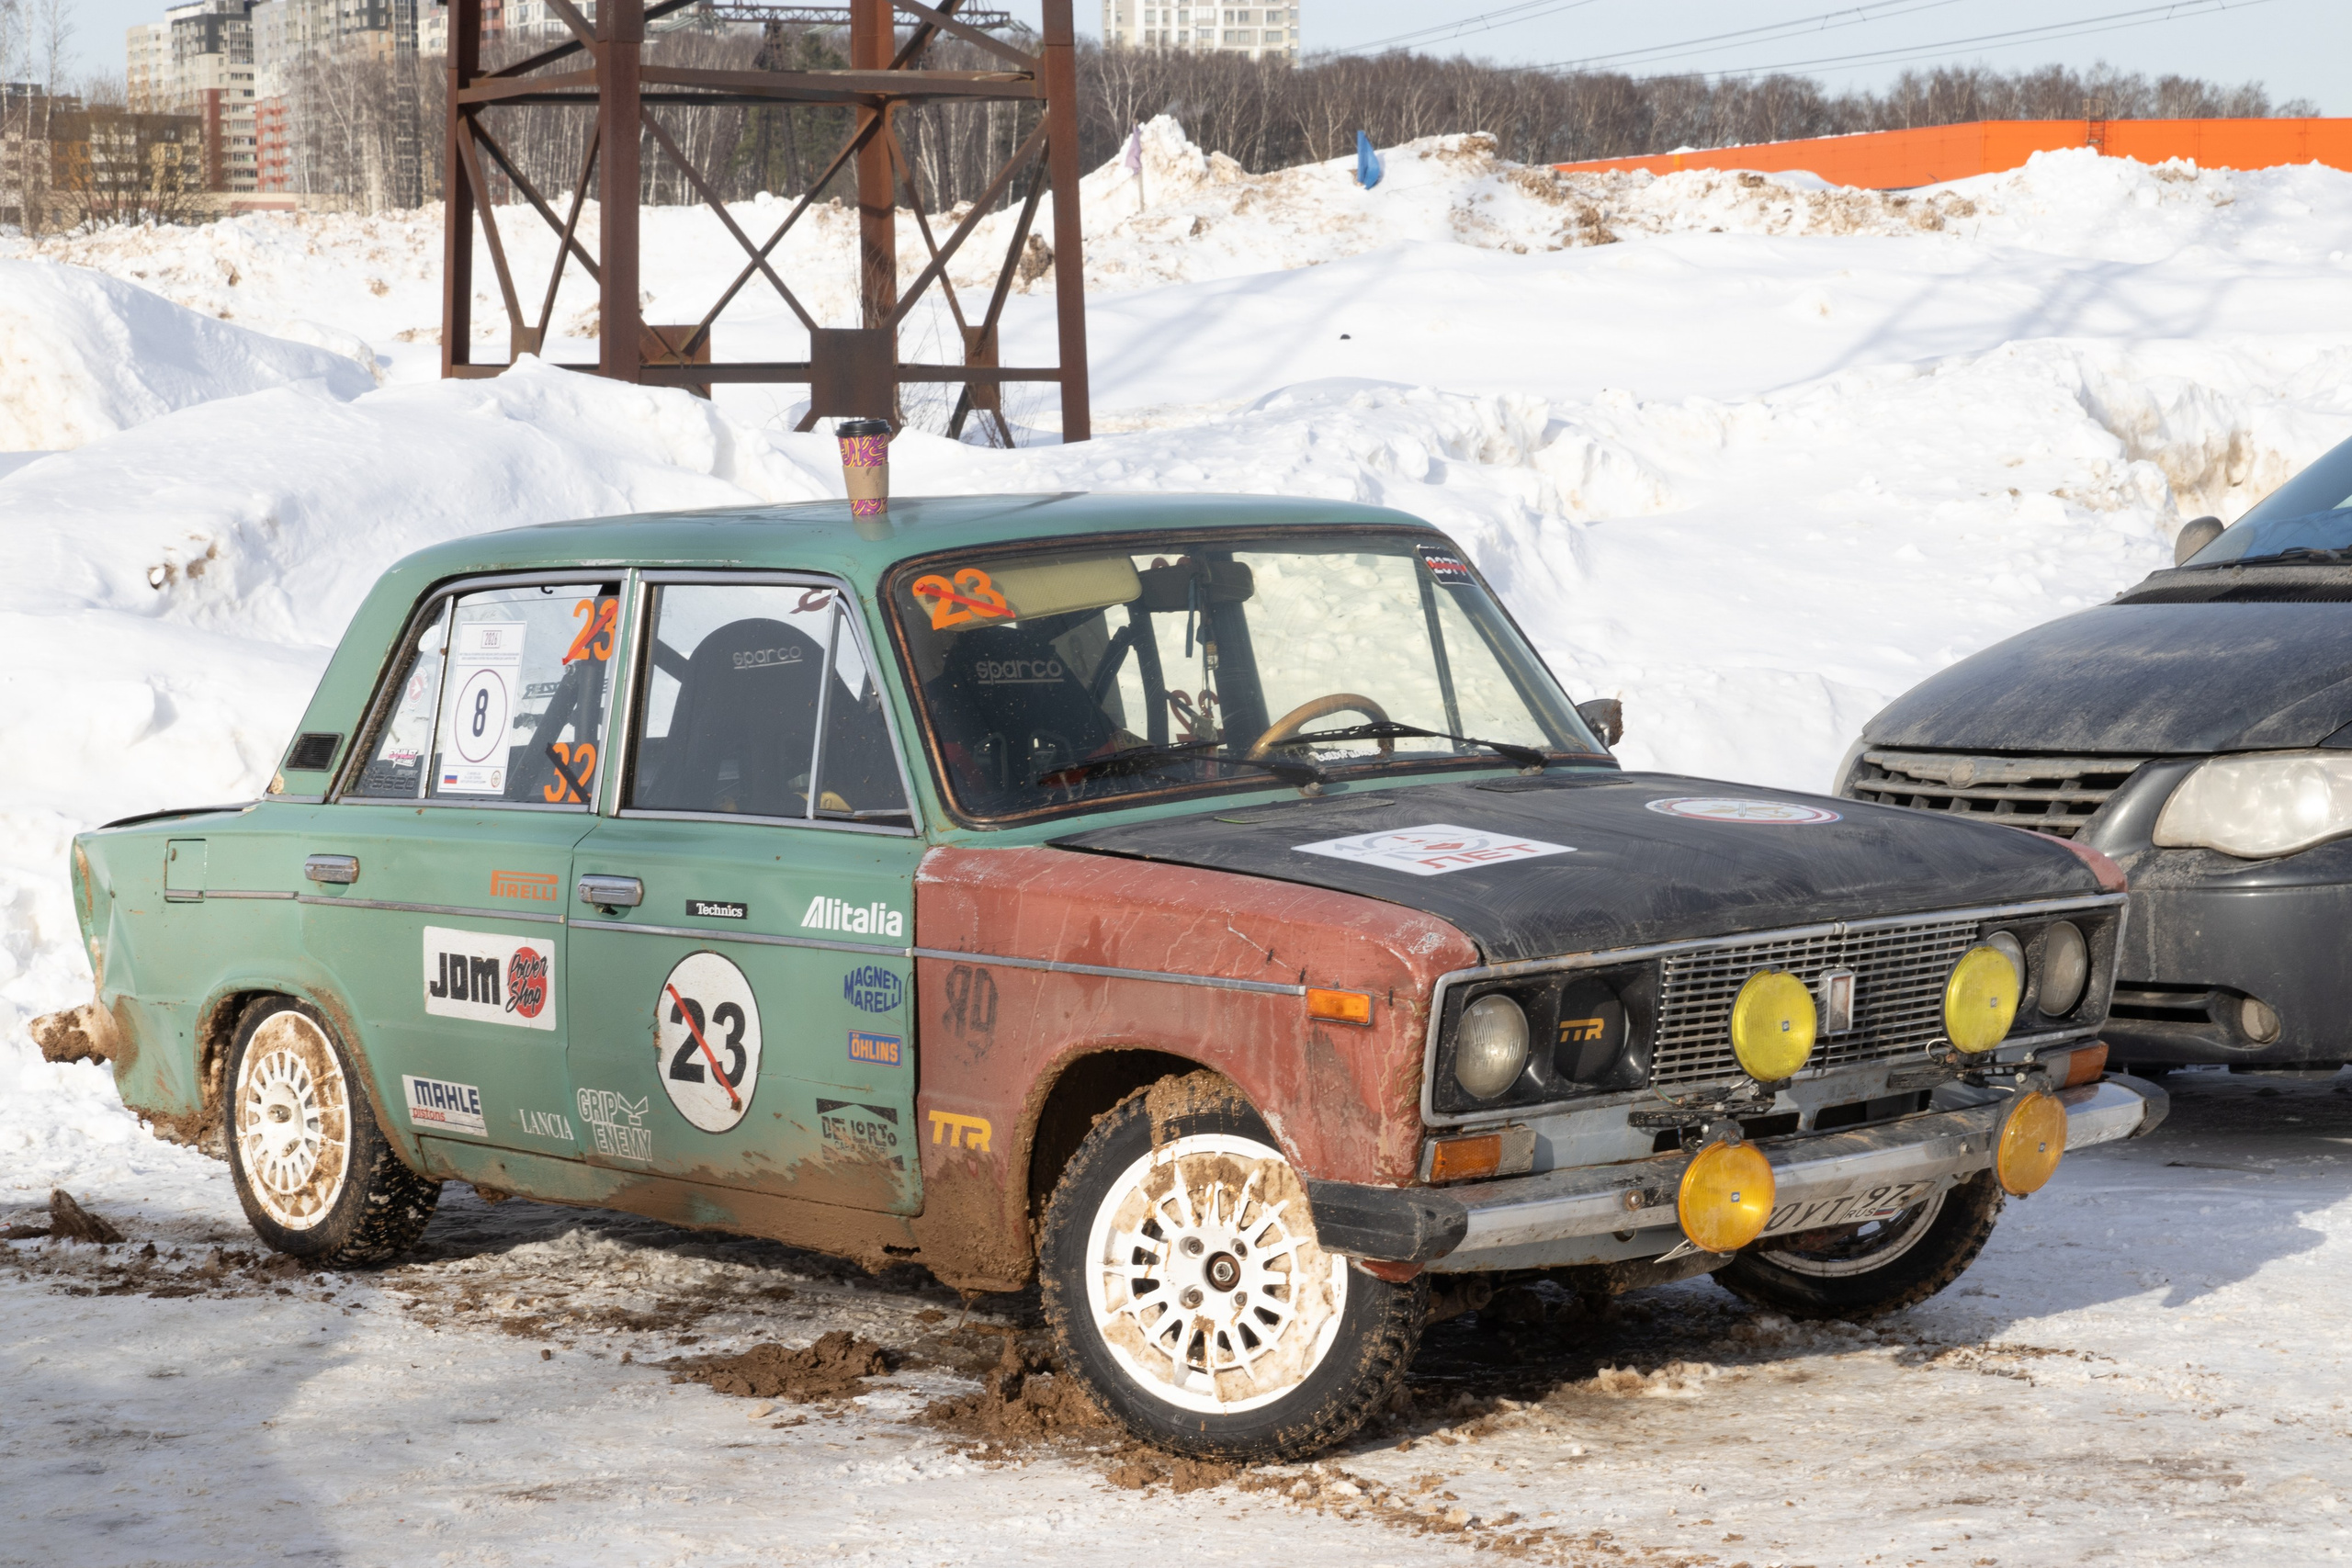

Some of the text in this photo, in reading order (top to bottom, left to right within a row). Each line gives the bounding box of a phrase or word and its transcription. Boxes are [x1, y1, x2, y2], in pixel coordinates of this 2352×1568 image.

[912, 568, 1007, 631] 23
[567, 599, 618, 660] 23
[732, 646, 801, 670] sparco
[976, 659, 1062, 684] sparco
[472, 689, 489, 738] 8
[544, 742, 596, 803] 32
[1416, 843, 1540, 869] ЛЕТ
[490, 870, 559, 901] PIRELLI
[695, 903, 743, 918] Technics
[801, 896, 903, 937] Alitalia
[429, 952, 501, 1006] JDM
[507, 953, 548, 987] Power
[505, 979, 543, 1015] Shop
[669, 998, 748, 1089] 23
[851, 1033, 899, 1063] ÖHLINS
[1559, 1018, 1605, 1043] TTR
[413, 1079, 481, 1115] MAHLE
[413, 1106, 446, 1122] pistons
[577, 1088, 618, 1124] GRIP
[518, 1109, 574, 1141] LANCIA
[593, 1122, 653, 1162] ENEMY
[928, 1110, 992, 1153] TTR
[1844, 1208, 1875, 1220] RUS
